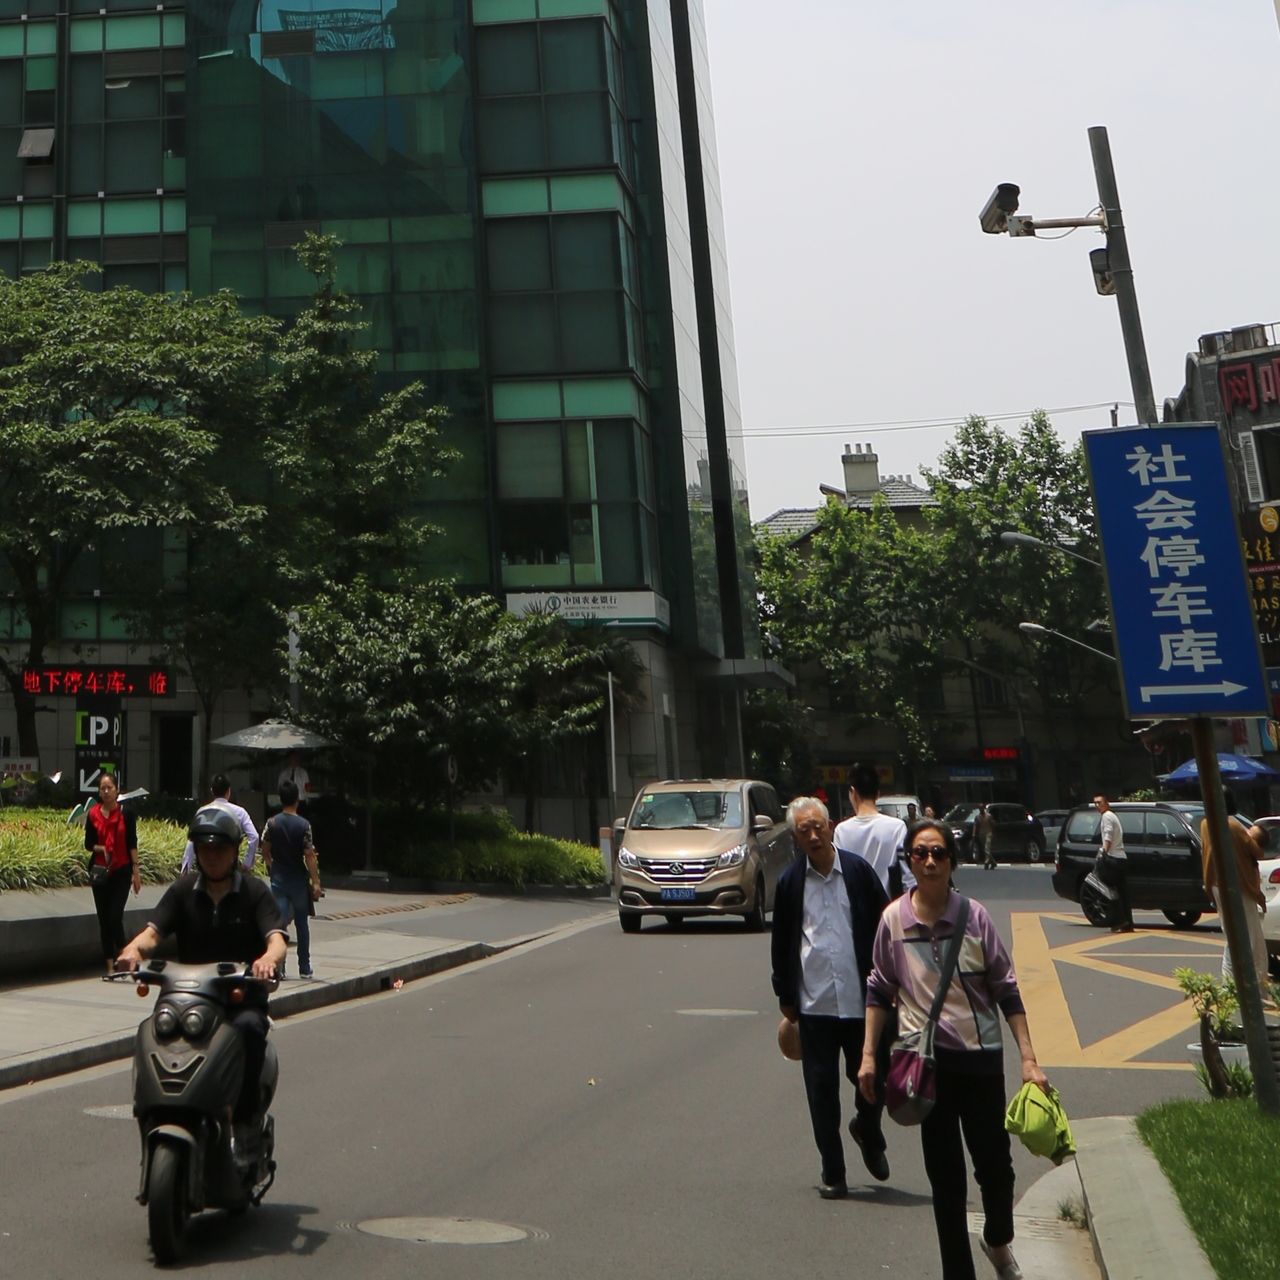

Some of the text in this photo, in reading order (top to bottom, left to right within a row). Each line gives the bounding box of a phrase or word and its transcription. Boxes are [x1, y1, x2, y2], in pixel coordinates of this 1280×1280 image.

[1125, 444, 1223, 673] 社会停车库
